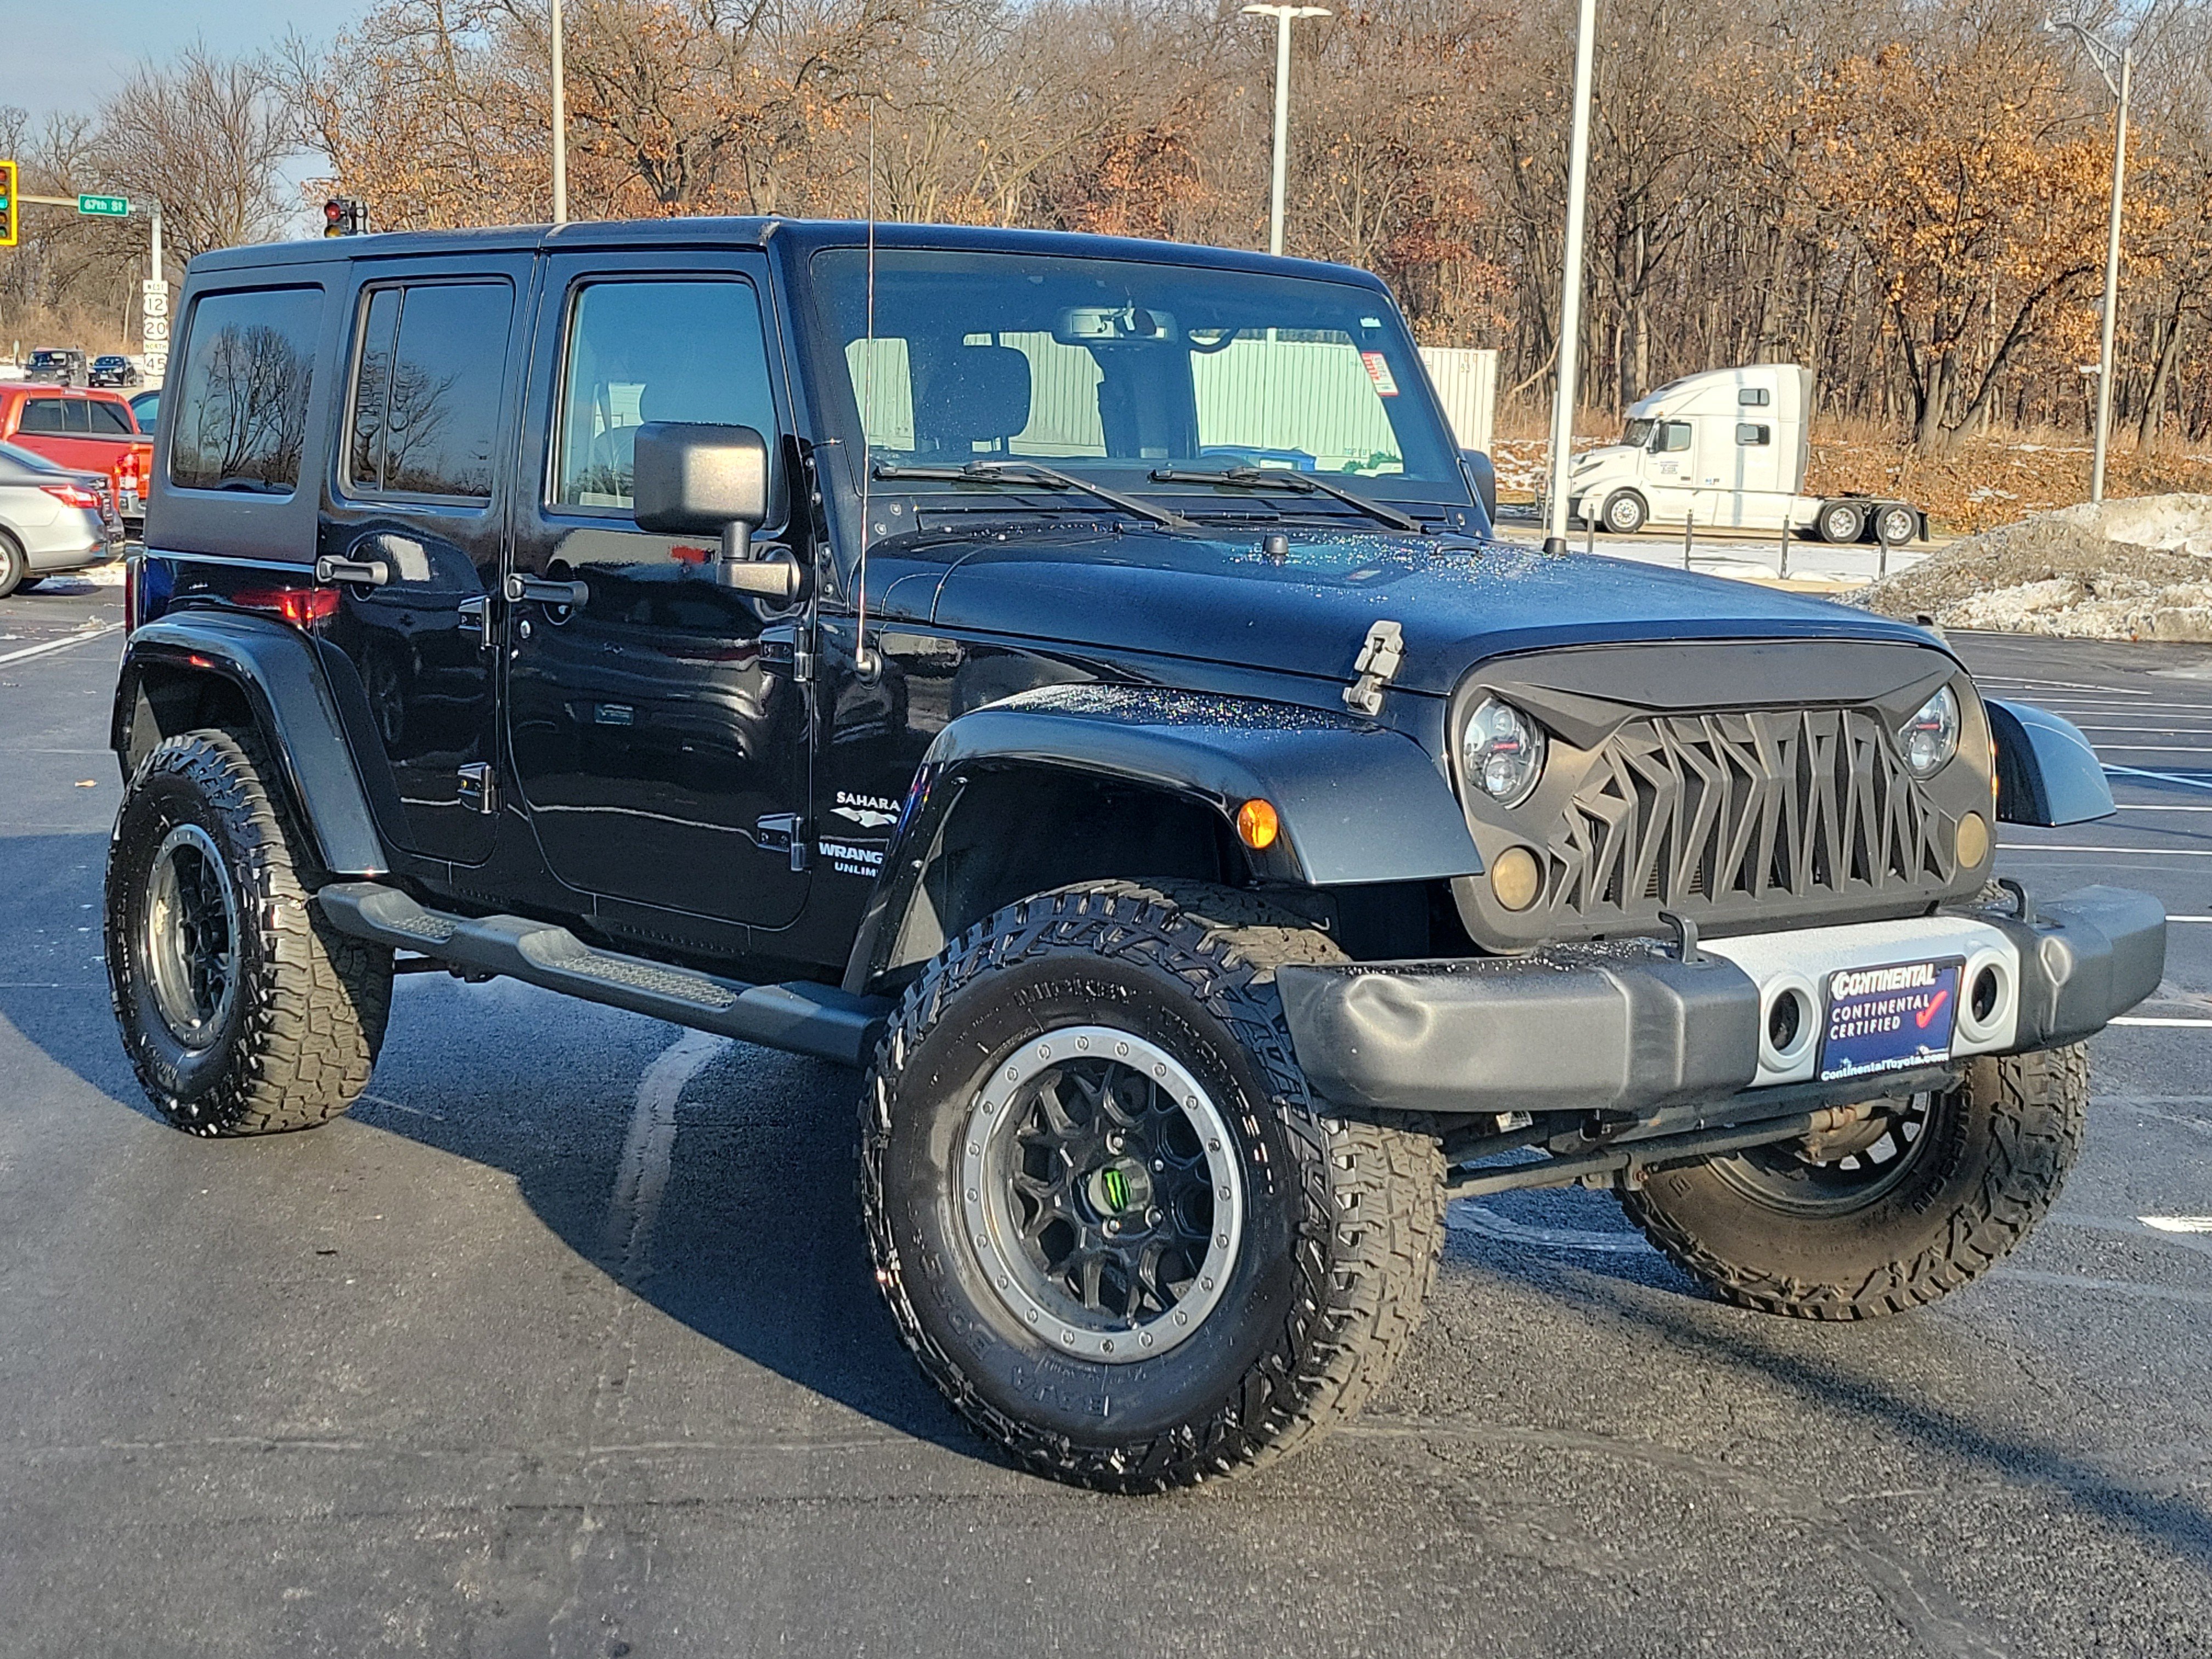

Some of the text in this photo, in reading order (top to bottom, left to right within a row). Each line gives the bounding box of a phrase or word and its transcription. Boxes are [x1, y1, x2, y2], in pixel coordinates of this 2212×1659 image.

[84, 199, 123, 212] 67th St
[149, 298, 163, 311] 12
[146, 322, 166, 335] 20
[146, 358, 166, 370] 45
[837, 791, 901, 812] SAHARA
[819, 842, 884, 865] WRANG
[834, 861, 879, 877] UNLIM
[1830, 963, 1936, 1001] CONTINENTAL
[1831, 994, 1929, 1023] CONTINENTAL
[1830, 1015, 1900, 1040] CERTIFIED
[1820, 1053, 1949, 1081] ContinentalToyota.com
